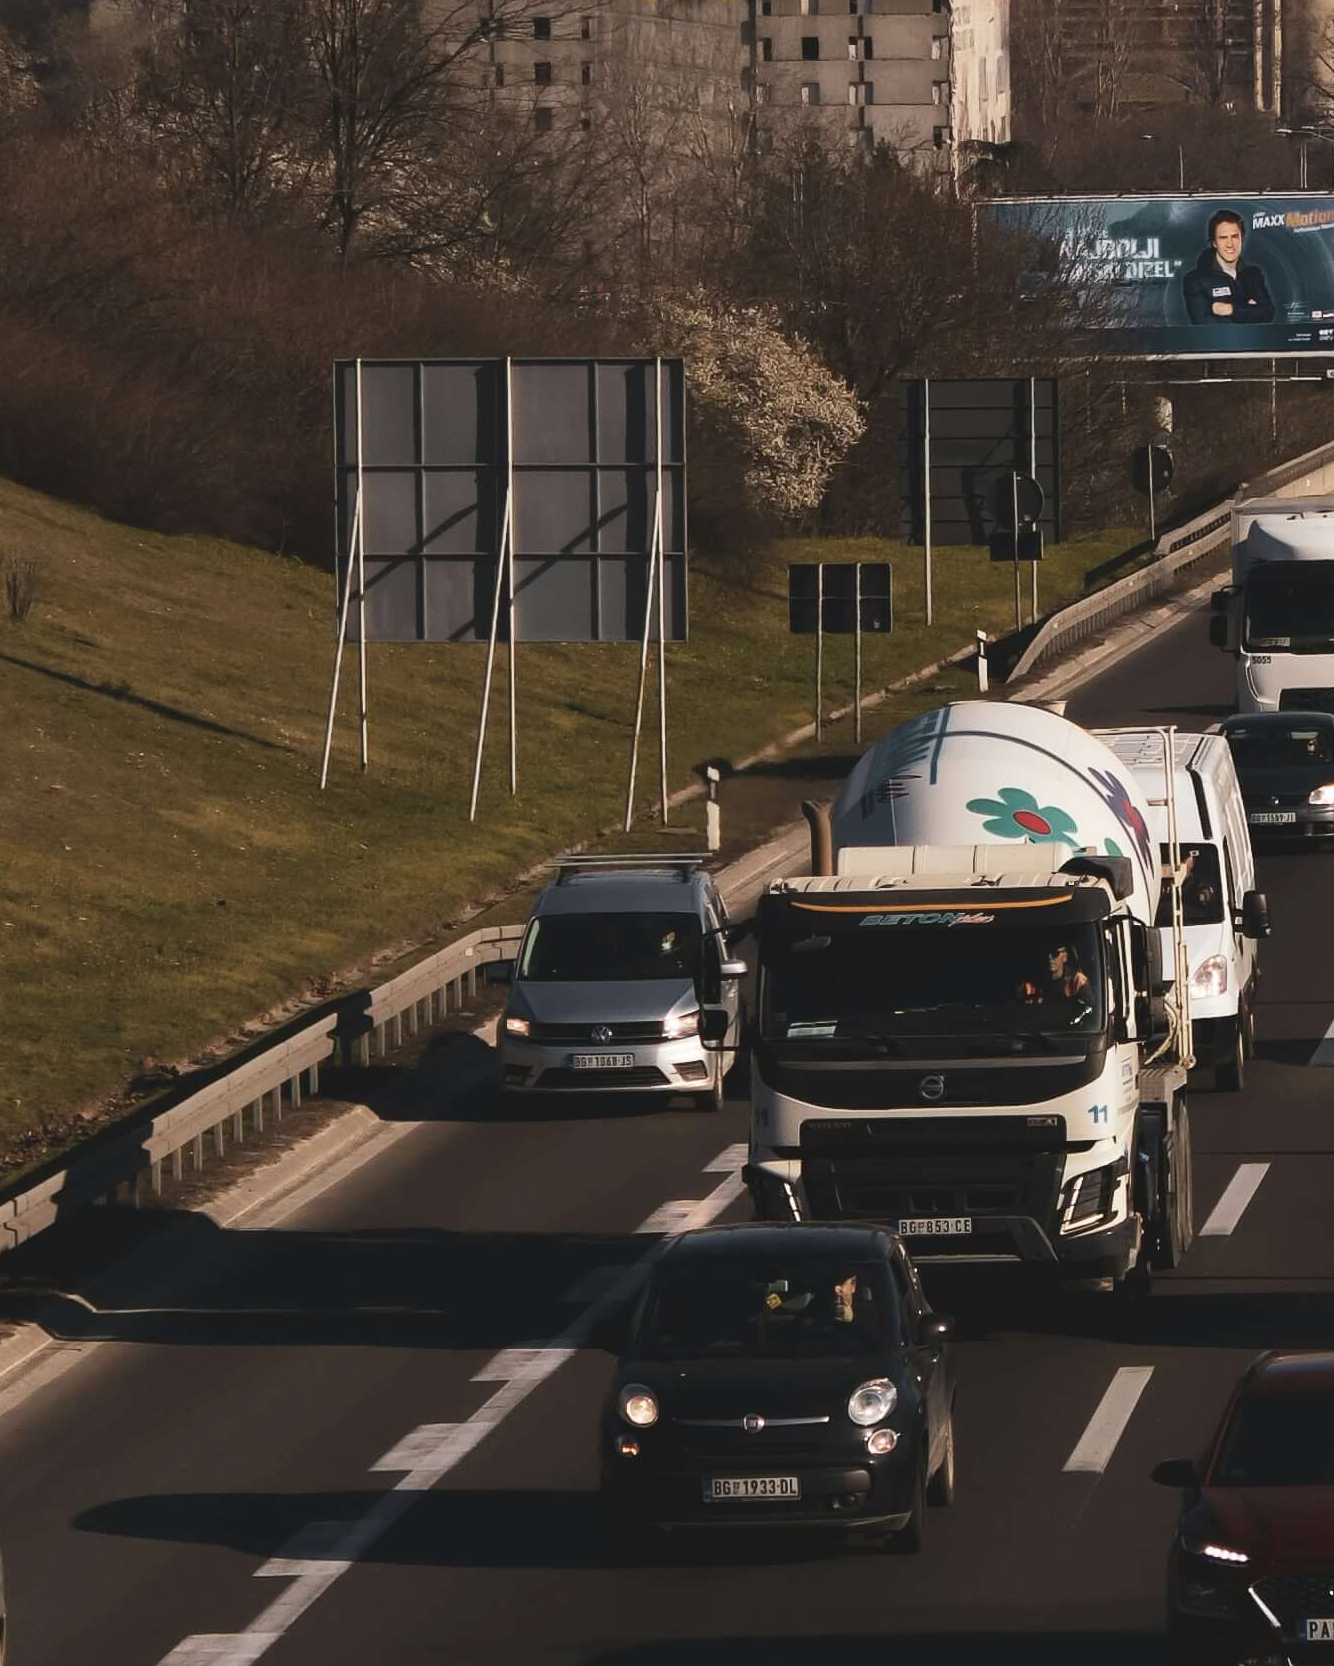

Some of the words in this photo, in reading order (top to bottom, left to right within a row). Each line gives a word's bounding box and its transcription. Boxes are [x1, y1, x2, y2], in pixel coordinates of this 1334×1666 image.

[859, 913, 960, 927] BETON
[1087, 1104, 1109, 1124] 11
[901, 1221, 916, 1234] BG
[714, 1480, 731, 1496] BG
[1308, 1621, 1329, 1638] PA
